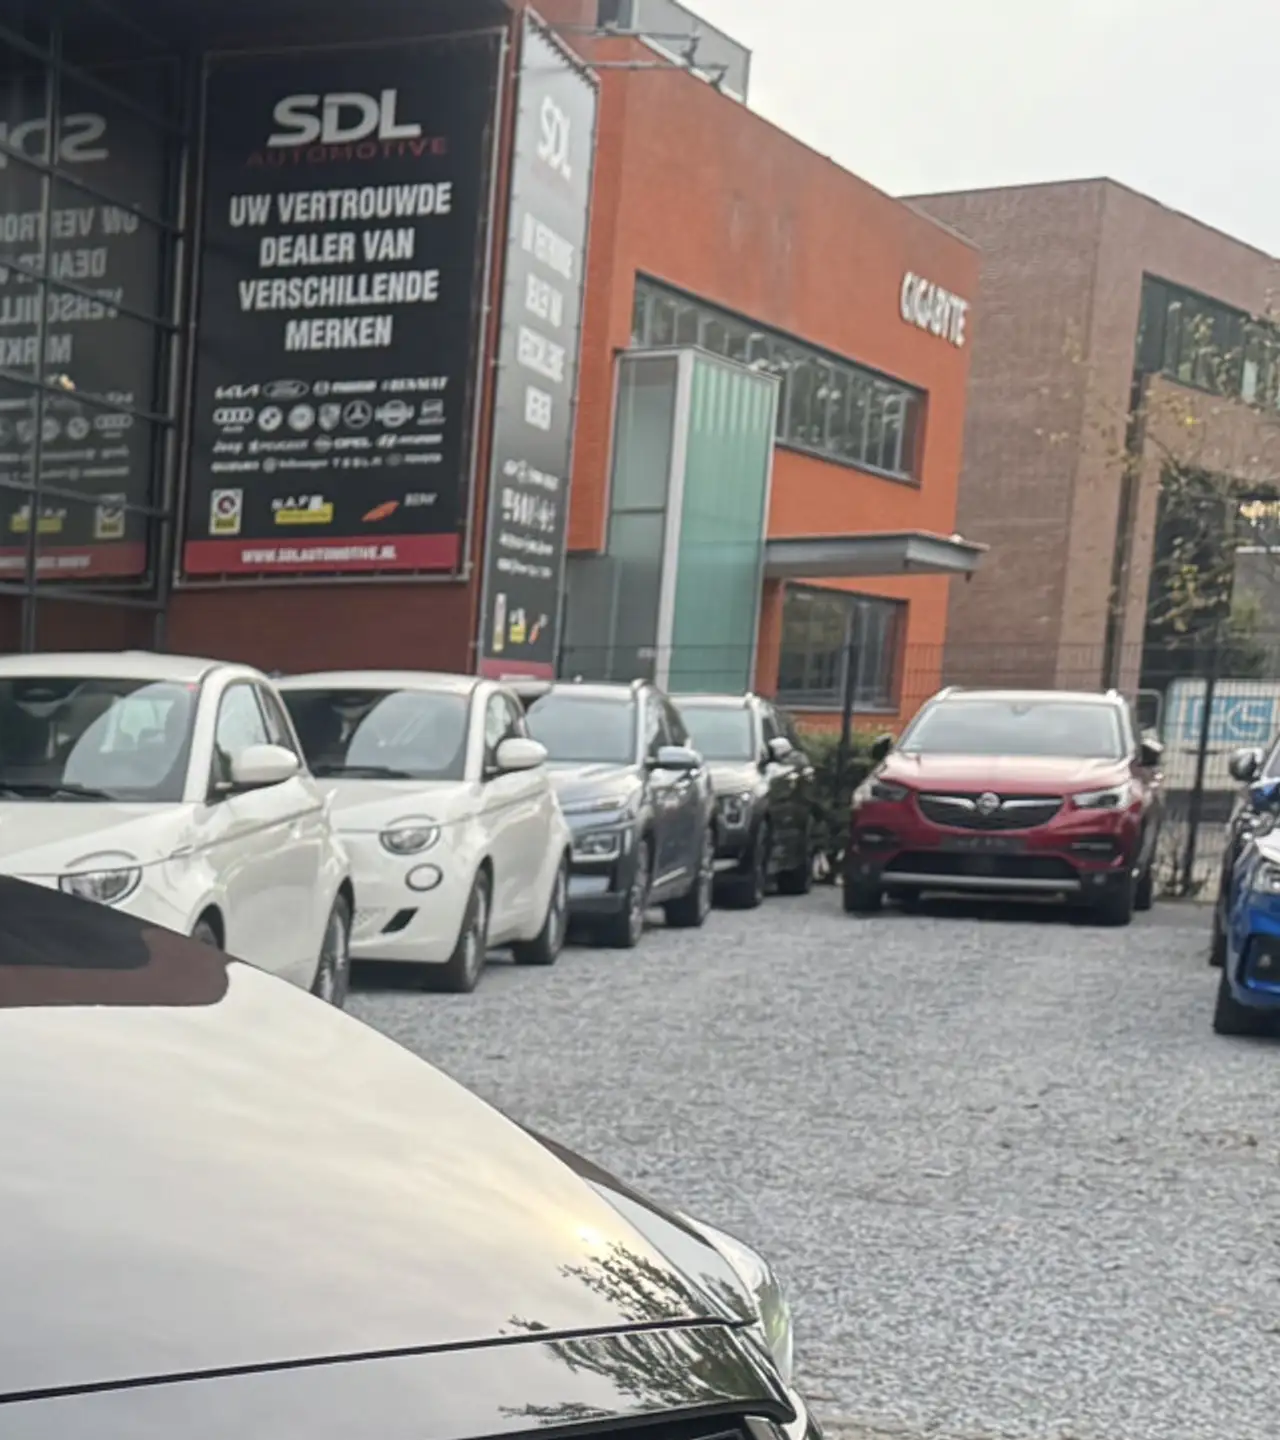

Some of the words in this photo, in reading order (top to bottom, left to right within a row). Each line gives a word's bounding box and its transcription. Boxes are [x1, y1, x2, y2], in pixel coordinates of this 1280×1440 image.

[267, 88, 422, 147] SDL
[244, 136, 449, 169] AUTOMOTIVE
[229, 194, 272, 227] UW
[278, 182, 453, 224] VERTROUWDE
[259, 232, 356, 268] DEALER
[362, 227, 416, 262] VAN
[239, 269, 440, 311] VERSCHILLENDE
[900, 271, 970, 348] GIGABYTE
[284, 315, 393, 351] MERKEN
